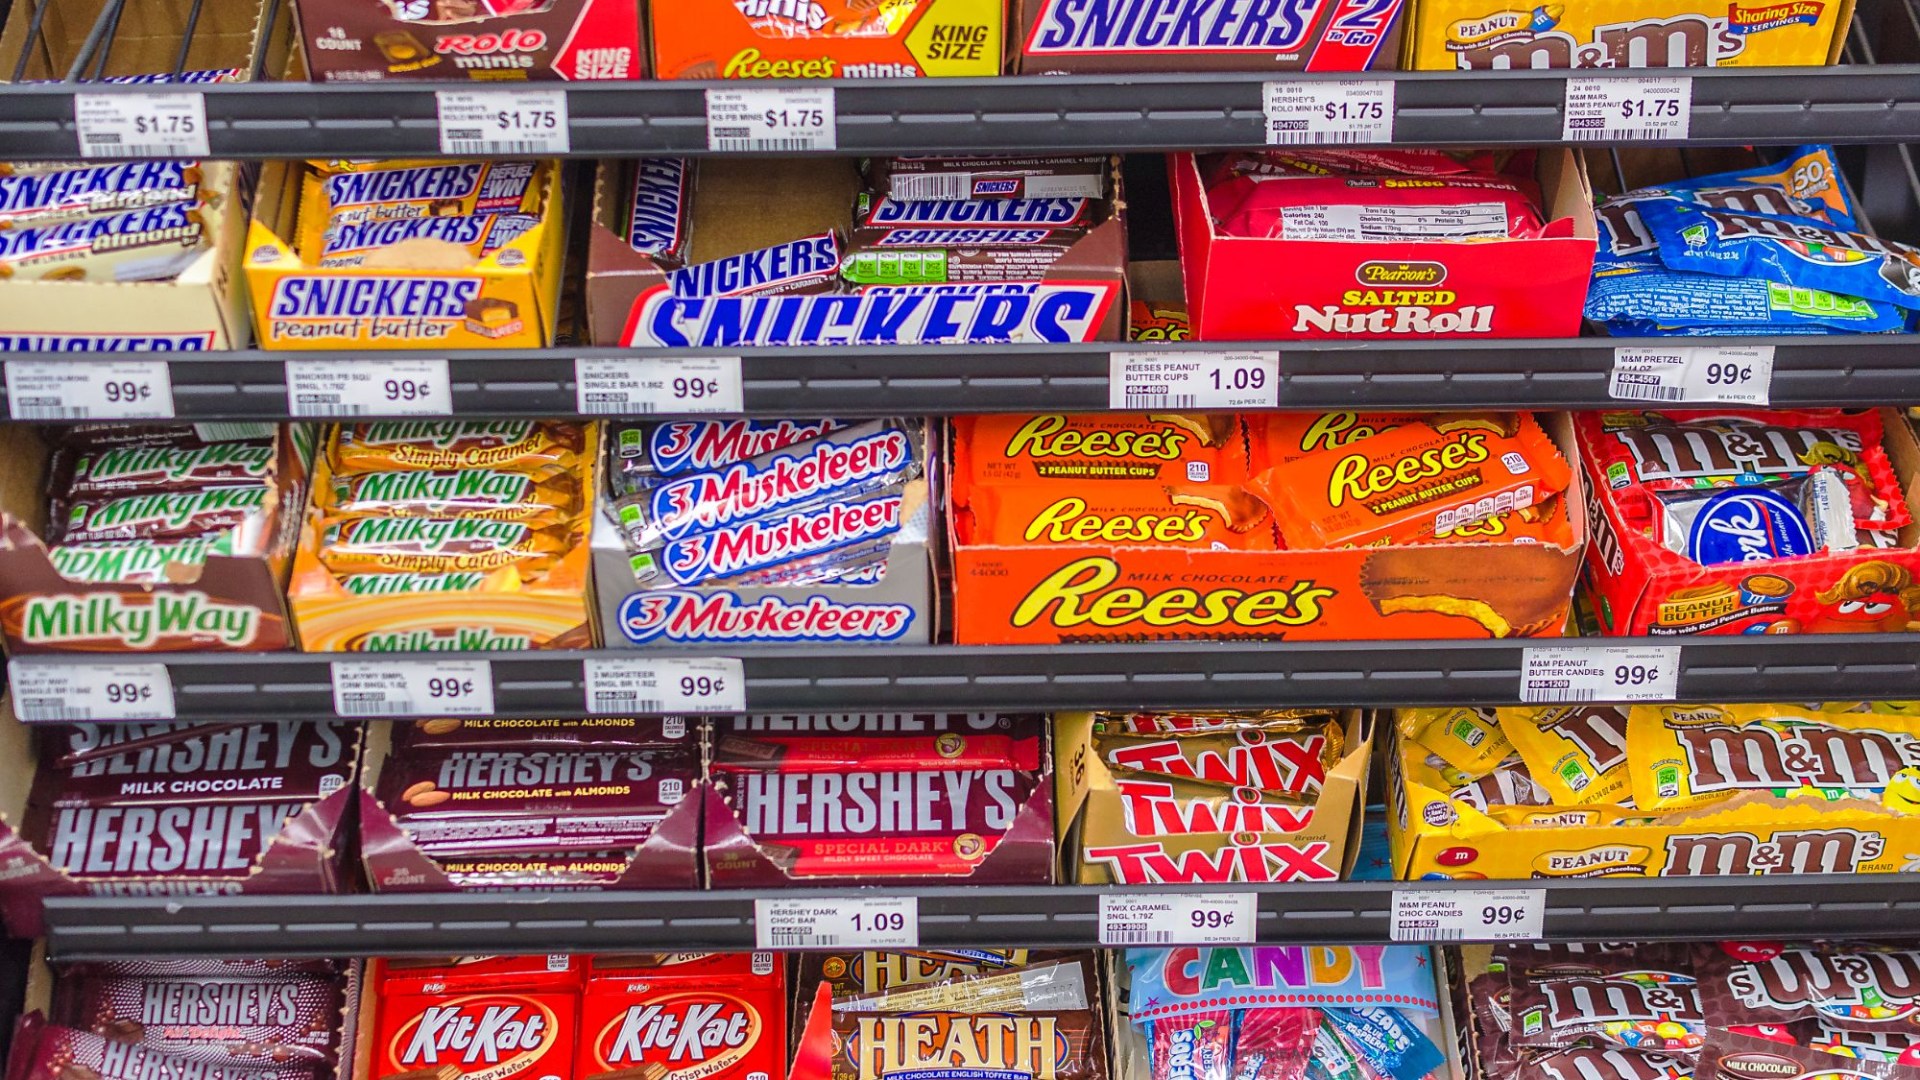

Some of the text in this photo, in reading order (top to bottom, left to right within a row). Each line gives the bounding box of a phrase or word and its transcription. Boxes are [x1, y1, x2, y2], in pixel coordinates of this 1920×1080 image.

[1734, 3, 1818, 25] Sharing Size
[1460, 16, 1518, 37] PEANUT
[1751, 16, 1800, 31] SERVINGS
[931, 25, 988, 43] KING
[1326, 30, 1376, 46] To Go
[575, 47, 630, 64] KING
[926, 43, 984, 60] SIZE
[454, 53, 534, 69] minis
[724, 48, 917, 79] Reese's minis
[575, 64, 628, 79] SIZE
[1325, 102, 1383, 121] $1.75
[1621, 99, 1679, 119] $1.75
[136, 116, 194, 134] $1.75
[498, 111, 556, 129] $1.75
[765, 110, 823, 128] $1.75
[1569, 119, 1605, 128] 4943585
[961, 159, 1001, 167] CHOCOLATE
[489, 166, 533, 180] REFUEL
[1789, 160, 1825, 194] 150
[331, 163, 483, 206] SNICKERS
[488, 179, 526, 198] WIN
[974, 181, 1017, 193] SNICKERS
[877, 197, 1083, 223] SNICKERS
[92, 224, 200, 250] Almond
[885, 229, 1049, 245] SATISFIES
[1364, 262, 1437, 284] Pearson's
[790, 277, 823, 291] CARAMEL
[278, 278, 478, 317] SNICKERS
[1342, 290, 1456, 307] SALTED
[371, 317, 452, 337] butter
[1292, 305, 1494, 333] Nut Roll
[1125, 363, 1200, 372] REESES PEANUT
[1621, 355, 1684, 364] M&M PRETZEL
[1125, 373, 1188, 381] BUTTER CUPS
[1210, 367, 1265, 390] 1.09
[1618, 374, 1660, 385] 494-4567
[1706, 363, 1752, 385] 99¢
[104, 380, 152, 402] 99¢
[384, 379, 431, 401] 99¢
[673, 377, 720, 399] 99¢
[1127, 385, 1167, 394] 494-4609
[657, 424, 697, 456] 3
[1005, 414, 1187, 460] Reese's
[396, 437, 542, 468] Simply Caramel
[1503, 453, 1522, 467] 210
[1039, 465, 1155, 477] 2 PEANUT BUTTER CUPS
[1188, 463, 1207, 473] 210
[1327, 432, 1490, 508] Reese's
[663, 432, 902, 528] 3 Musketeers
[1371, 474, 1480, 514] 2 PEANUT BUTTER CUPS
[1023, 497, 1213, 542] Reese's
[1127, 573, 1289, 584] MILK CHOCOLATE
[1009, 556, 1338, 628] Reese's
[1663, 603, 1736, 623] BUTTER
[1664, 595, 1735, 613] PEANUT
[632, 597, 903, 637] 3 Musketeers
[1651, 605, 1780, 636] Made with Real Peanut Butter
[1529, 659, 1588, 667] M&M PEANUT
[1529, 668, 1564, 677] BUTTER
[1614, 665, 1659, 687] 99¢
[106, 683, 153, 703] 99¢
[428, 678, 474, 698] 99¢
[680, 676, 726, 697] 99¢
[464, 718, 636, 728] MILK CHOCOLATE ALMONDS
[437, 752, 654, 789] HERSHEY'S
[1659, 773, 1676, 784] 250
[121, 777, 284, 795] MILK CHOCOLATE
[322, 777, 341, 787] 210
[661, 781, 681, 792] 210
[452, 785, 631, 800] MILK CHOCOLATE with ALMONDS
[748, 768, 1018, 835] HERSHEY'S
[1293, 834, 1327, 842] Brand
[813, 842, 944, 856] SPECIAL DARK
[479, 862, 627, 873] CHOCOLATE ALMONDS
[888, 855, 934, 863] CHOCOLATE
[1550, 850, 1630, 869] PEANUT
[1860, 863, 1894, 872] BRAND
[770, 908, 838, 916] HERSHEY DARK
[1190, 909, 1235, 929] 99¢
[1482, 906, 1525, 925] 99¢
[850, 912, 904, 932] 1.09
[1164, 946, 1387, 995] CANDY
[141, 982, 300, 1026] HERSHEY'S
[856, 1017, 1060, 1080] HEATH
[950, 1069, 1014, 1080] ENGLISH TOFFEE
[1725, 1060, 1798, 1075] MILK CHOCOLATE
